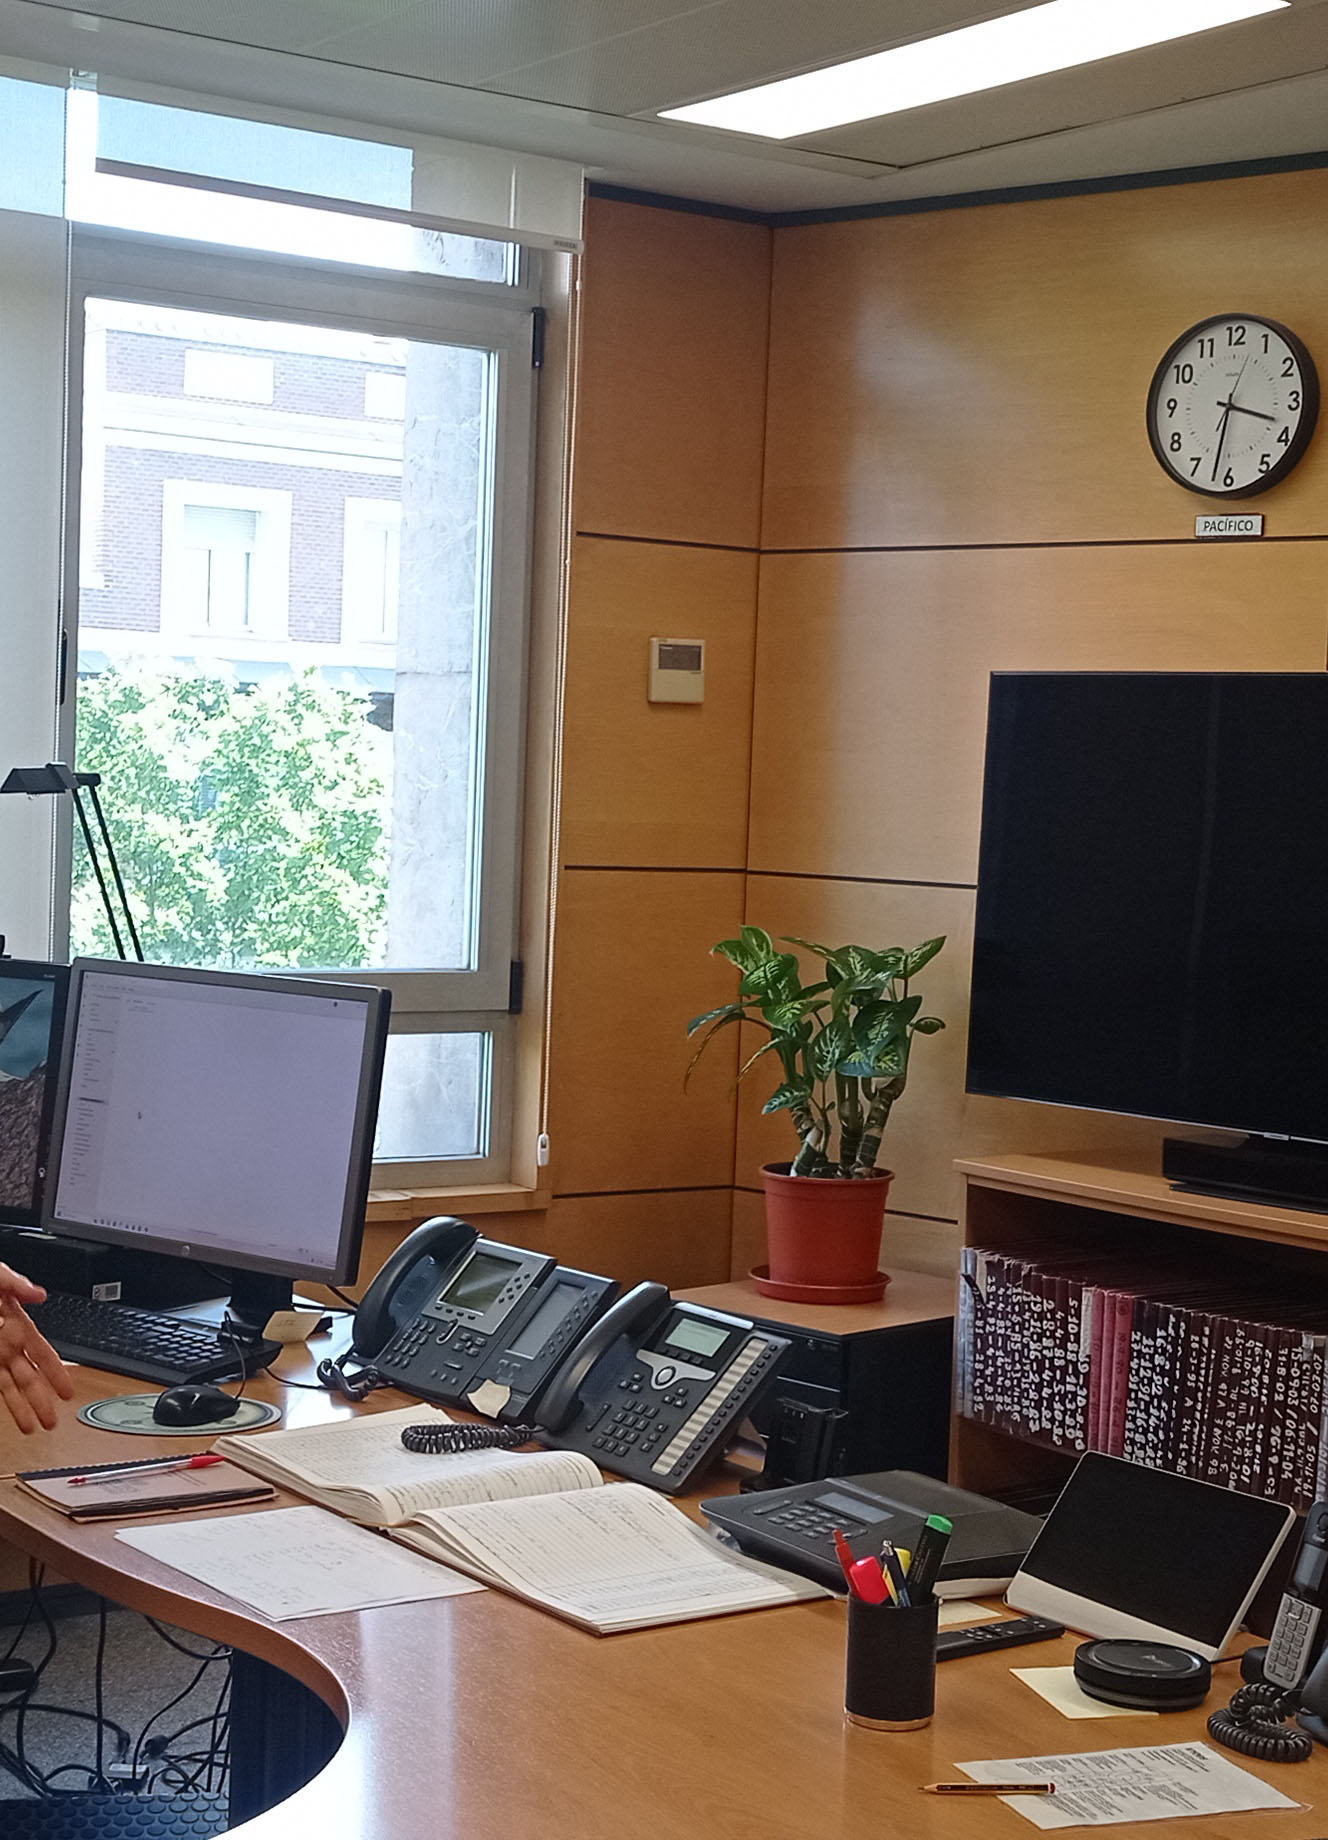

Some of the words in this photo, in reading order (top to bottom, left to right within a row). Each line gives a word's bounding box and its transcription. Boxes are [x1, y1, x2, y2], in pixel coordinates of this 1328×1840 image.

[1226, 325, 1246, 346] 12
[1261, 334, 1269, 353] 1
[1198, 338, 1214, 358] 11
[1173, 364, 1193, 384] 10
[1281, 357, 1294, 377] 2
[1167, 399, 1177, 418] 9
[1288, 391, 1300, 411] 3
[1170, 432, 1181, 451] 8
[1277, 427, 1289, 446] 4
[1190, 457, 1201, 476] 7
[1258, 454, 1271, 473] 5
[1224, 468, 1234, 487] 6
[1204, 518, 1253, 532] PACÍFICO
[1208, 1459, 1218, 1475] 98
